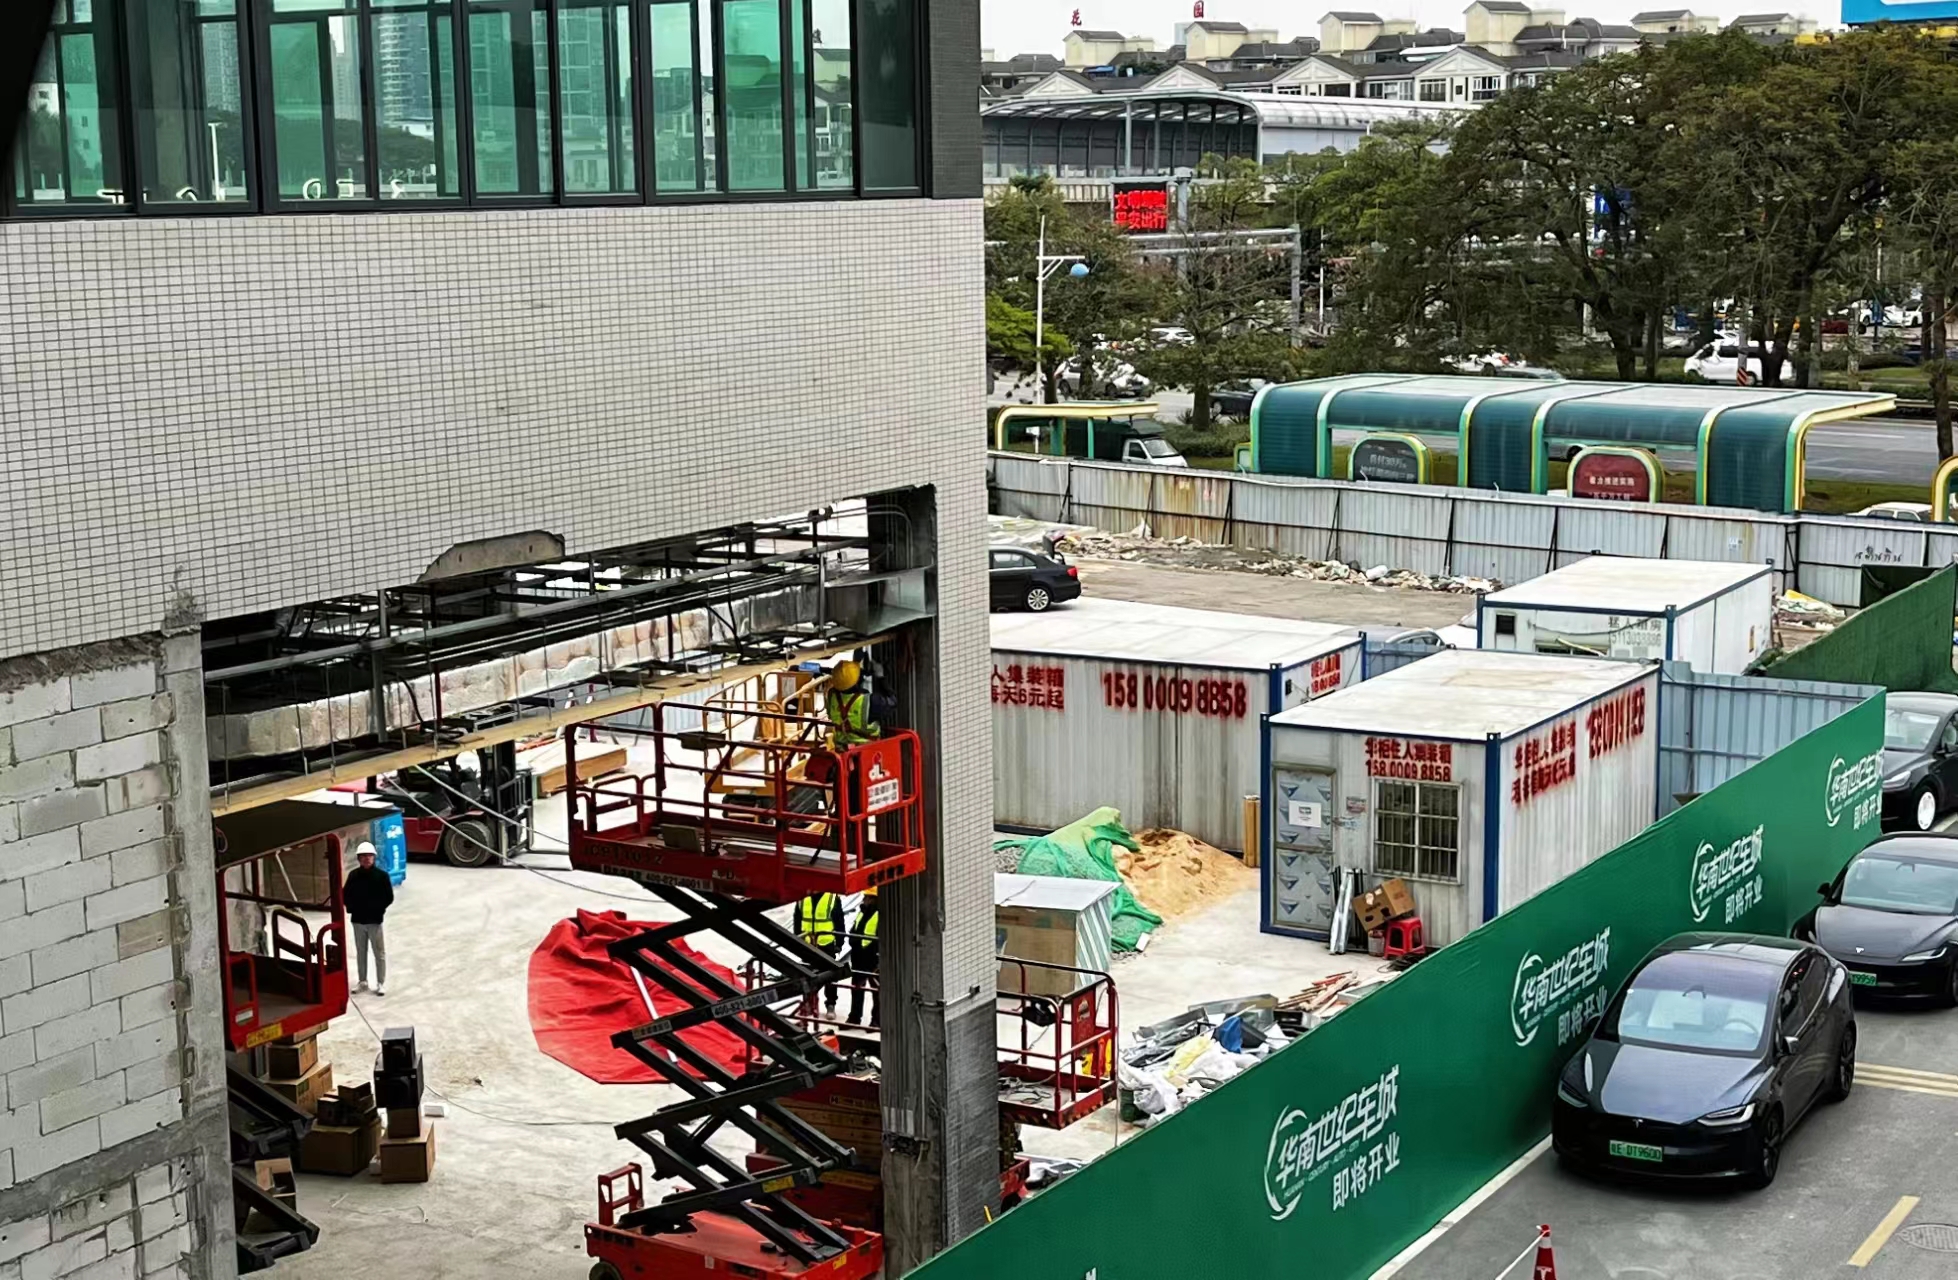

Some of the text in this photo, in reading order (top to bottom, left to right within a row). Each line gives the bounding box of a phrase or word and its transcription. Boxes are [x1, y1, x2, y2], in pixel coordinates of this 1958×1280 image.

[1696, 824, 1764, 900] 华南世纪车城
[1725, 874, 1763, 925] 即将开业
[1519, 926, 1611, 1020] 华南世纪车城
[1275, 1064, 1400, 1189] 华南世纪车城
[1333, 1131, 1400, 1211] 即将开业
